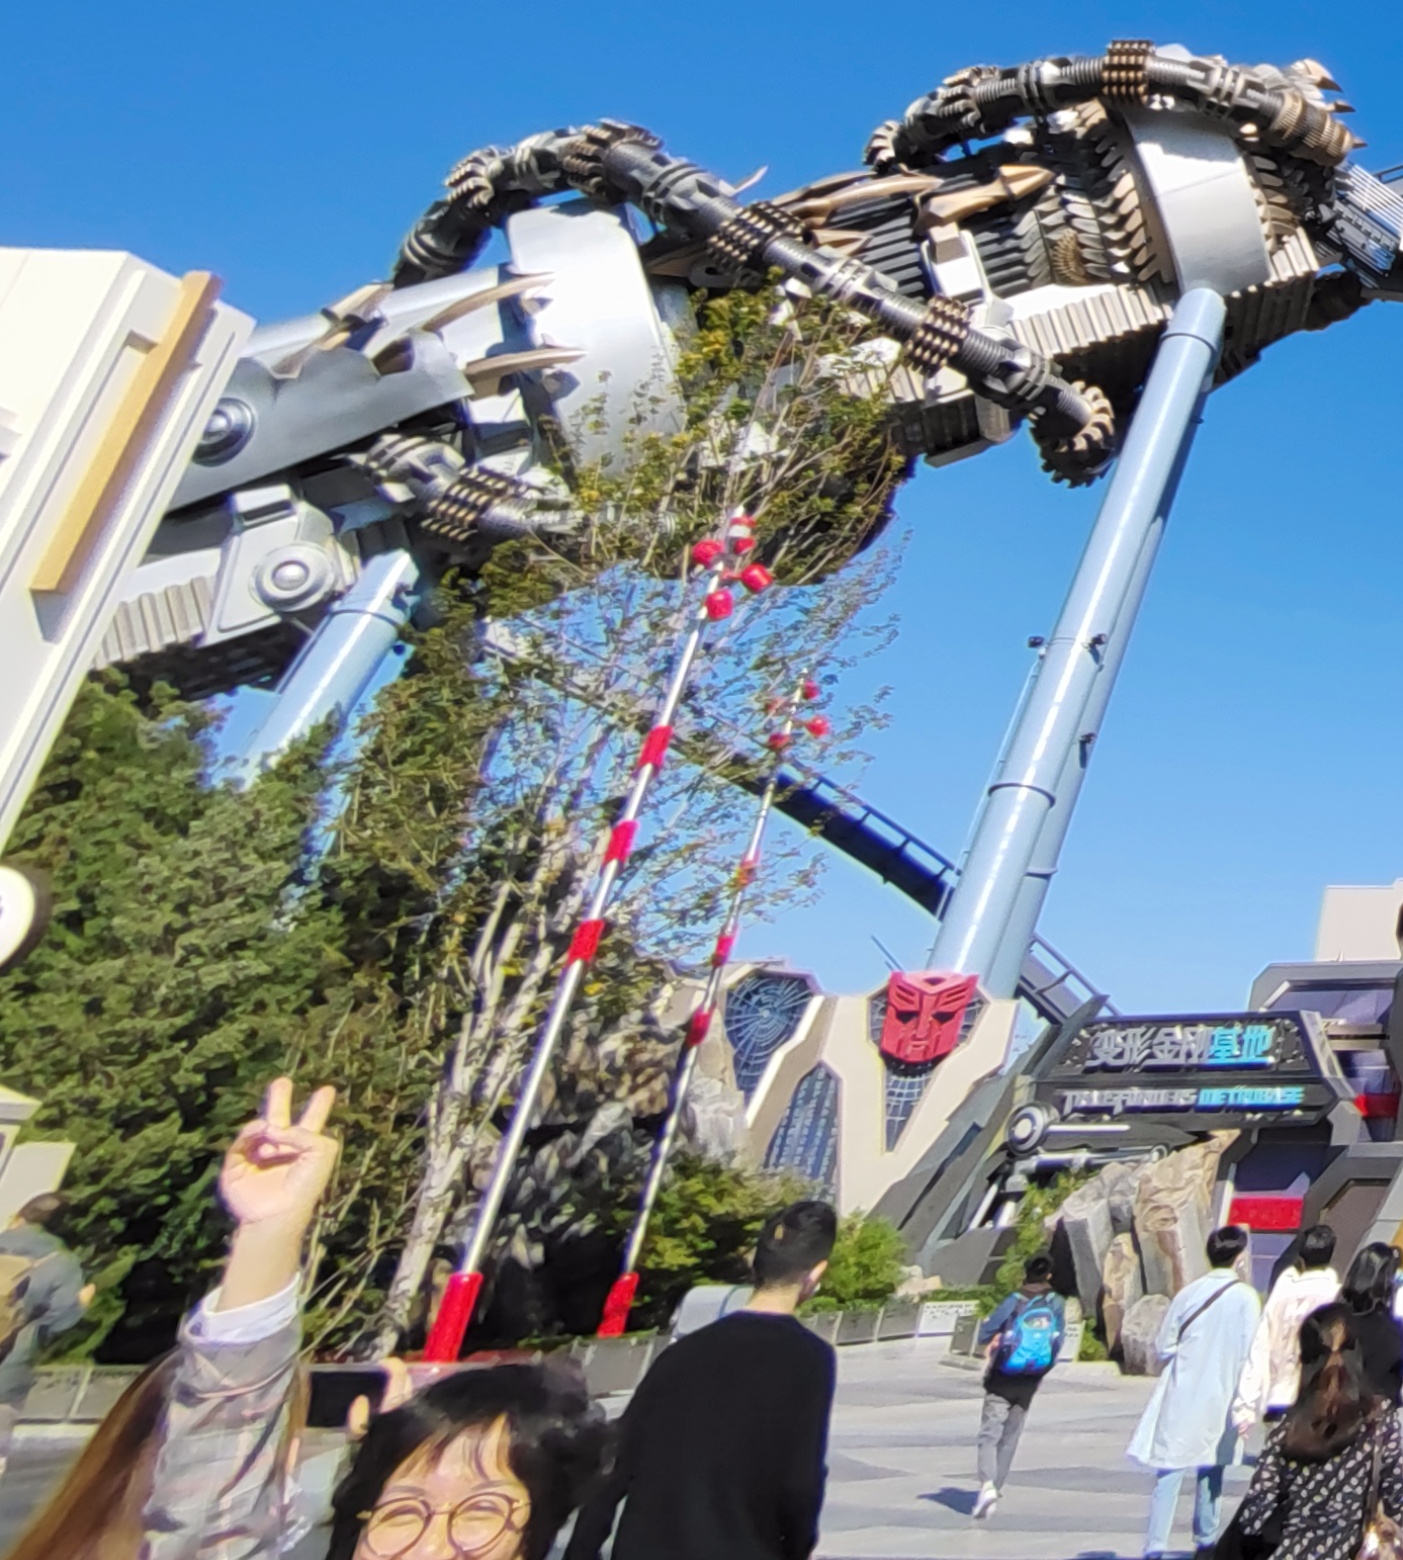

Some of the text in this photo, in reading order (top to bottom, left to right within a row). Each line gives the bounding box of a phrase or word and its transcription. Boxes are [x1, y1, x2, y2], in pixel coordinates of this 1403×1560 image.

[1084, 1024, 1276, 1070] 变形金刚基地
